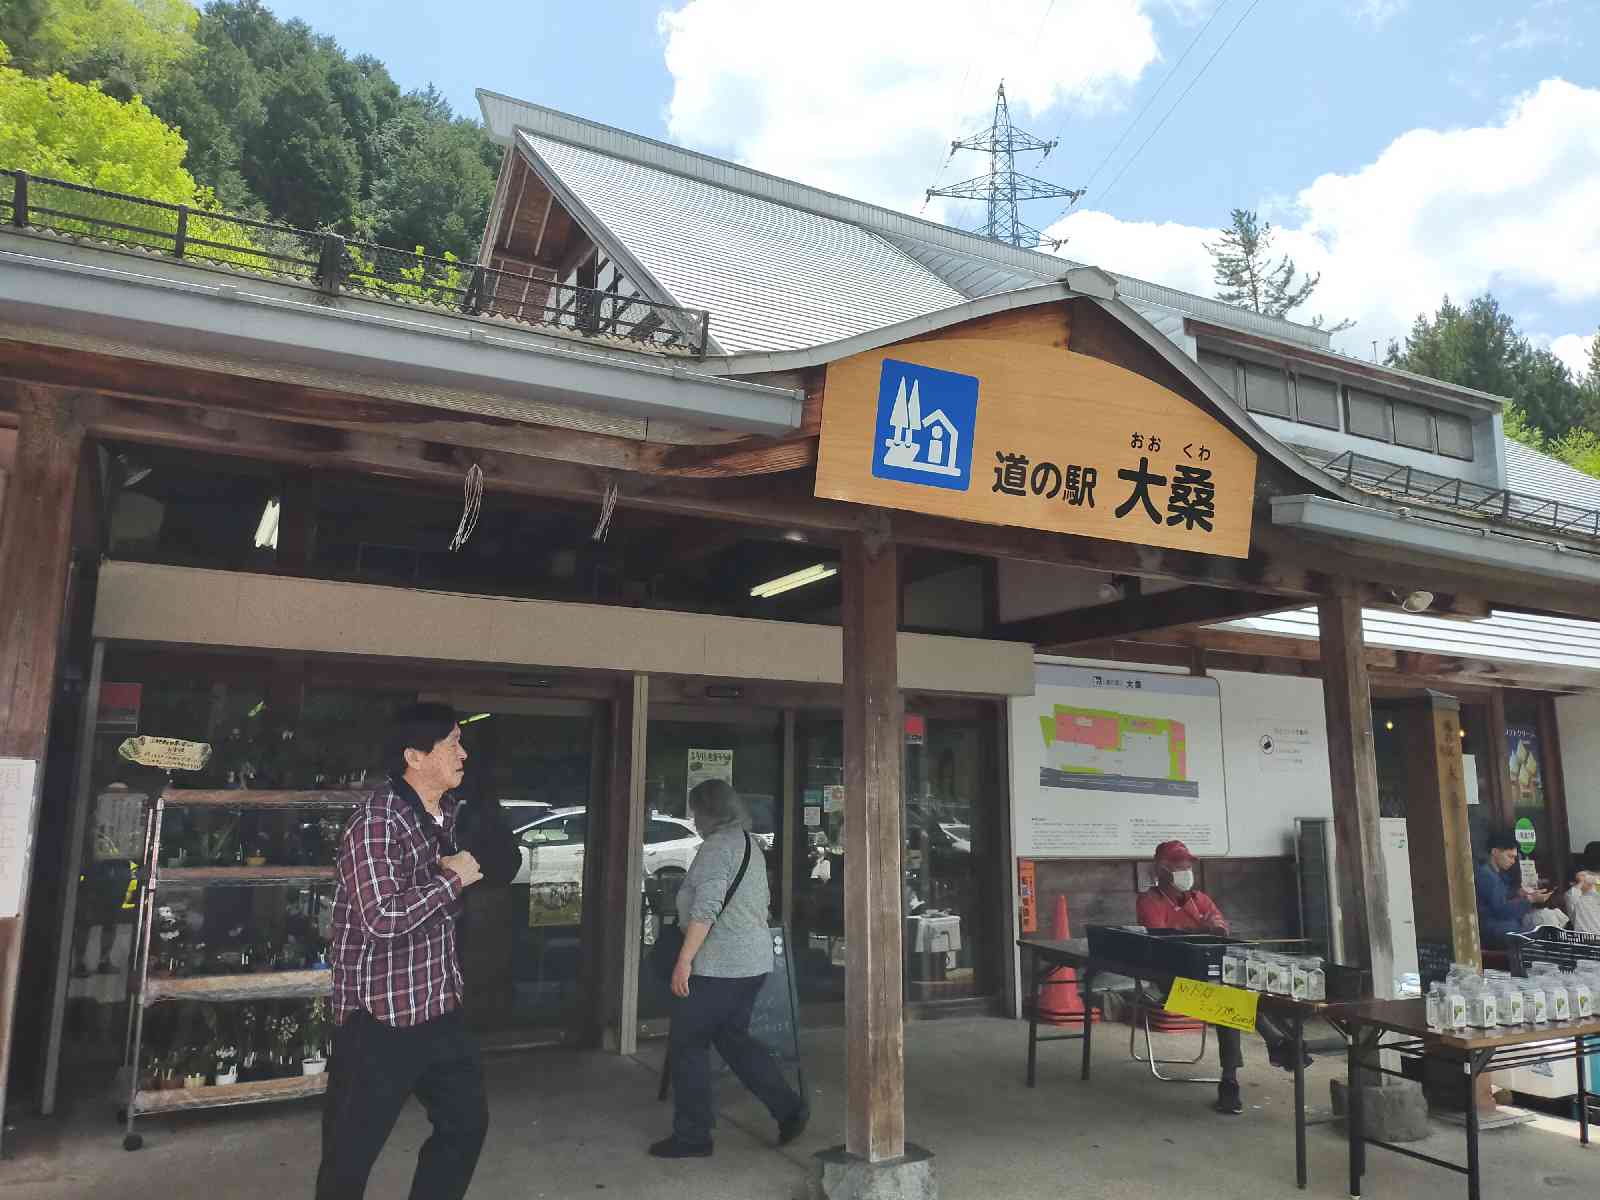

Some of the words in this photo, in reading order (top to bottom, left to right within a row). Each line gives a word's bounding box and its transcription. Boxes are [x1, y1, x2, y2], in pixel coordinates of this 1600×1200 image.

[1130, 432, 1161, 452] おお
[1183, 443, 1211, 461] くわ
[992, 451, 1097, 508] 道の駅
[1115, 457, 1215, 532] 大桑
